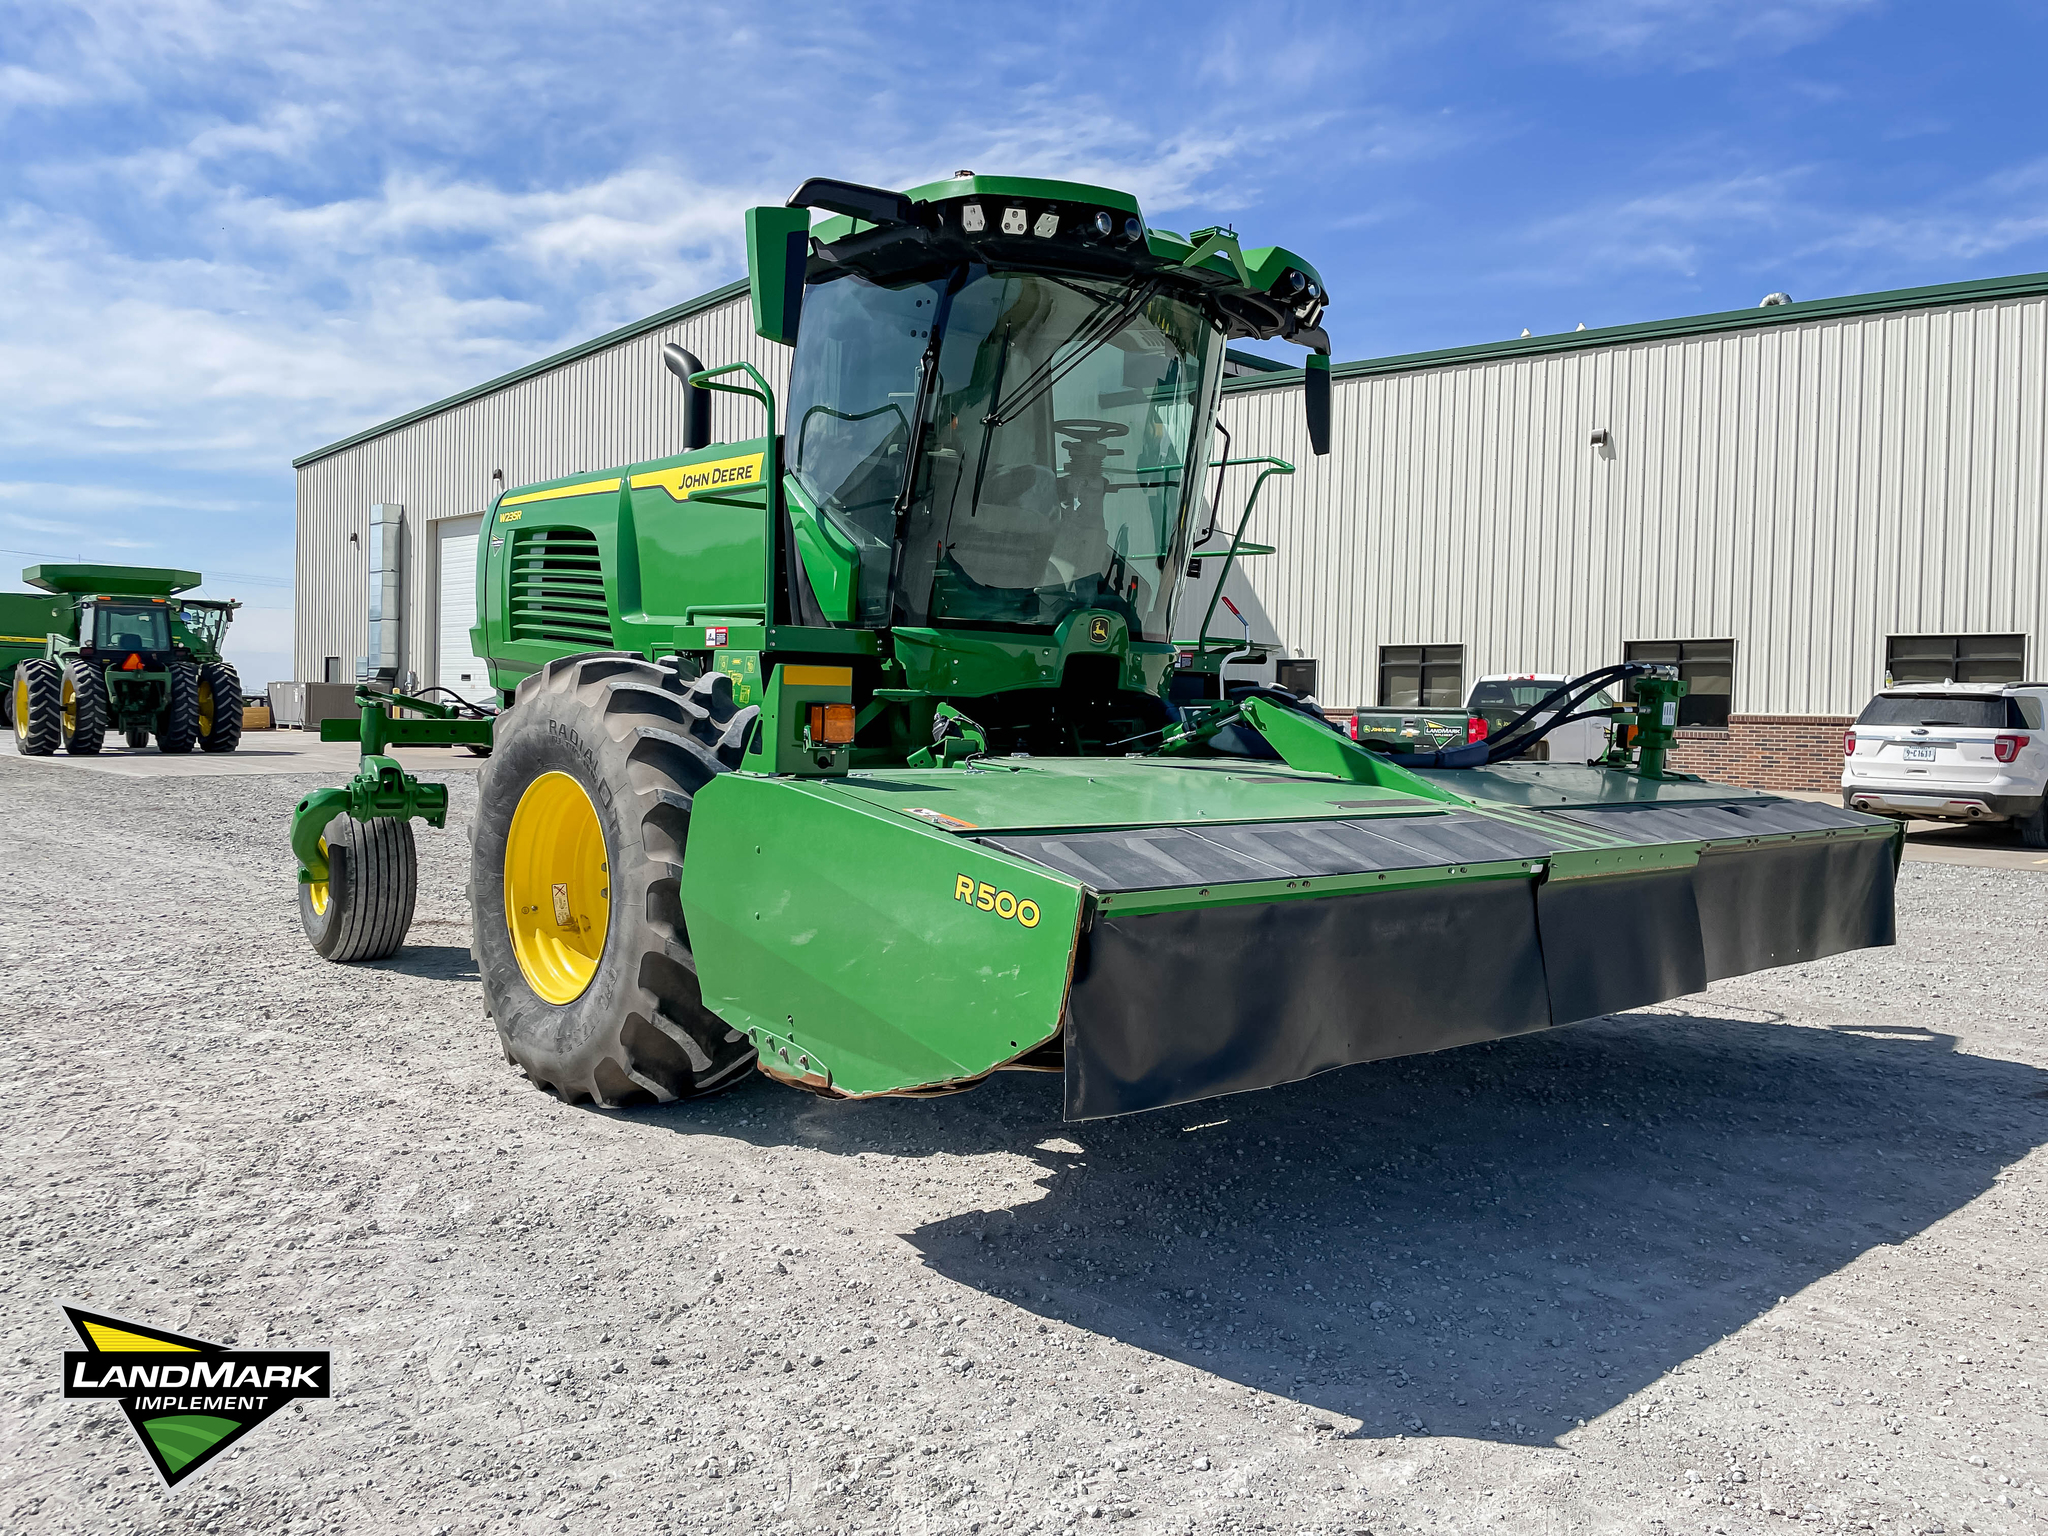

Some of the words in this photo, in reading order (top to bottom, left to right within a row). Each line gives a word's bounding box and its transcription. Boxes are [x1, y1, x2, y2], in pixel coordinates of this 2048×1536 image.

[678, 472, 711, 490] JOHN
[711, 464, 754, 485] DEERE
[499, 510, 523, 523] W235R
[548, 718, 600, 775] RADIAL
[953, 872, 1042, 929] R500
